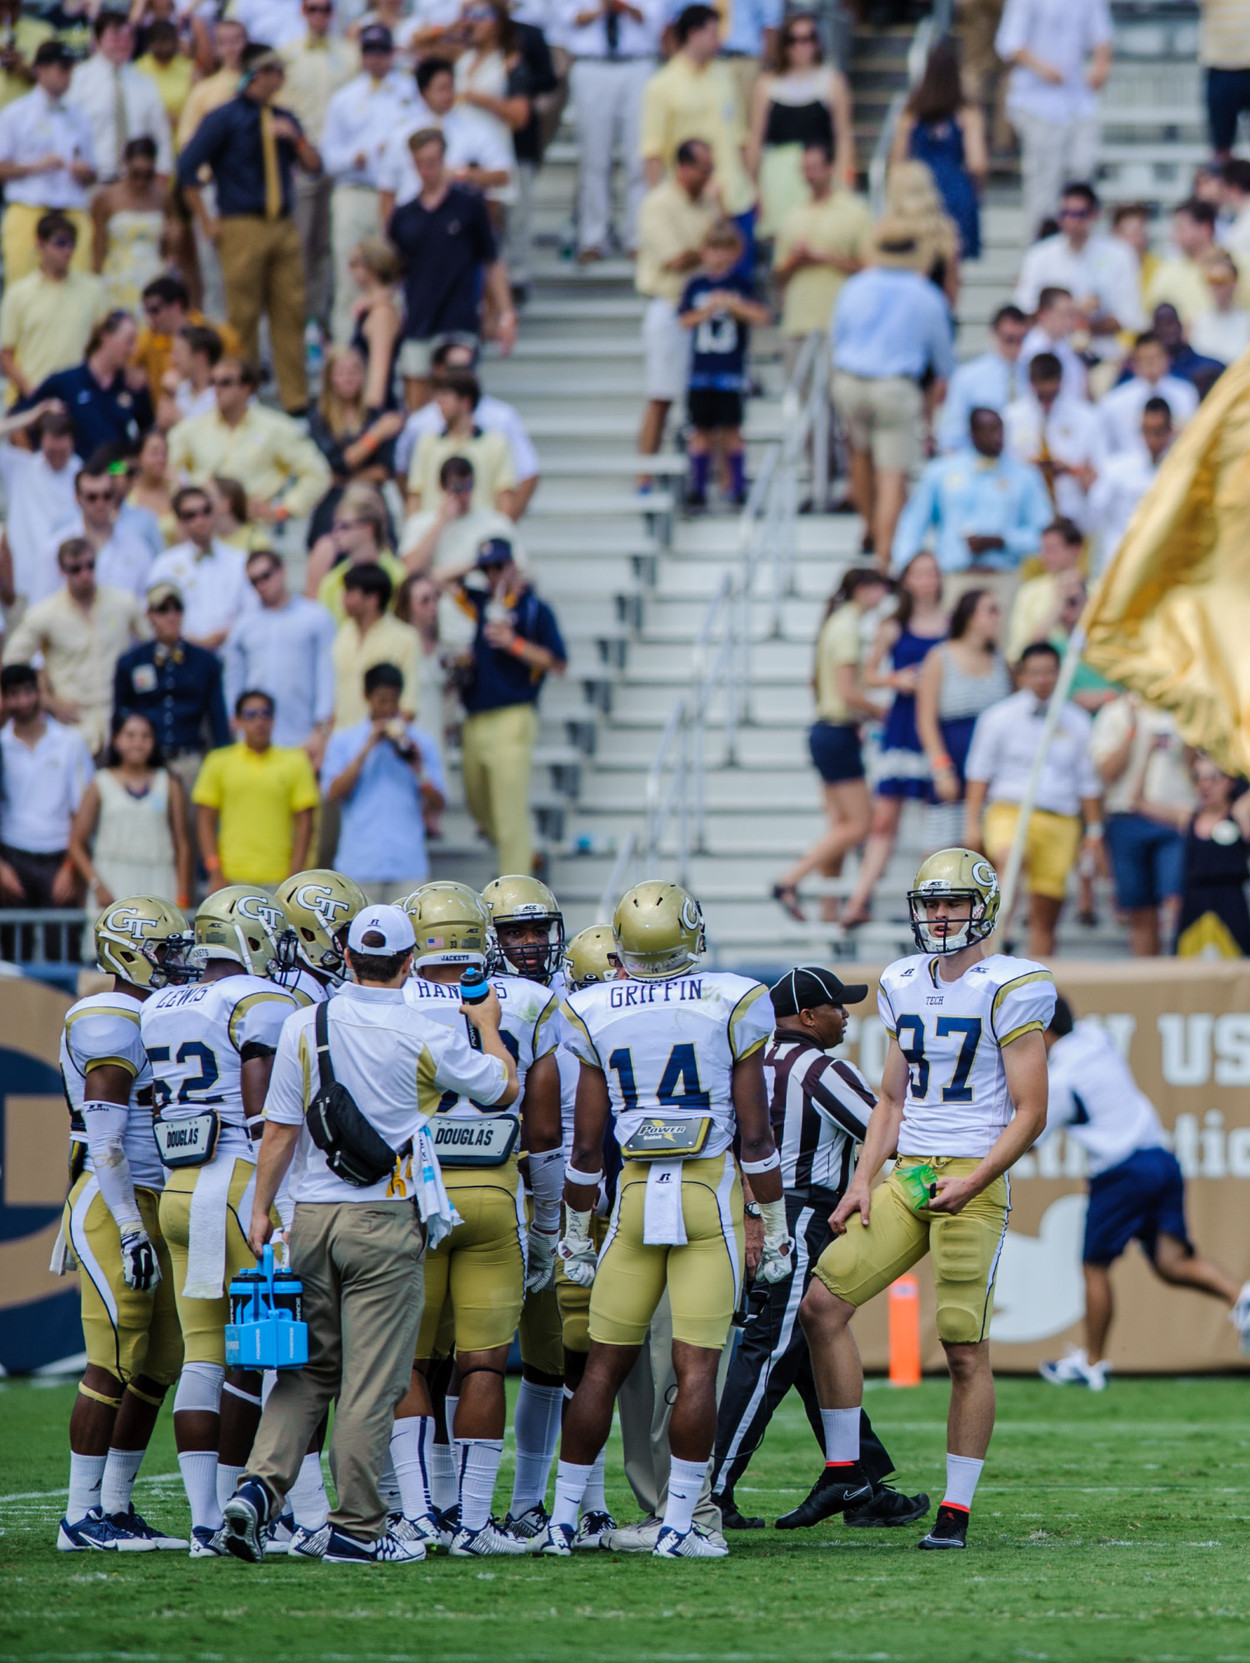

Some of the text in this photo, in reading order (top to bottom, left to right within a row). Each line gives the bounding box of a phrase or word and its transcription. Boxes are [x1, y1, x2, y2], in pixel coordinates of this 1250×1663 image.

[237, 895, 284, 930] GT
[296, 884, 349, 922] GT
[105, 907, 158, 940] GT
[415, 981, 508, 999] HANS
[610, 979, 703, 1008] GRIFFIN
[926, 995, 945, 1005] TECH
[145, 1039, 226, 1107] 52
[896, 1012, 984, 1104] 87
[608, 1041, 712, 1113] 14
[166, 1127, 200, 1149] DOUGLAS
[434, 1127, 494, 1146] DOUGLAS
